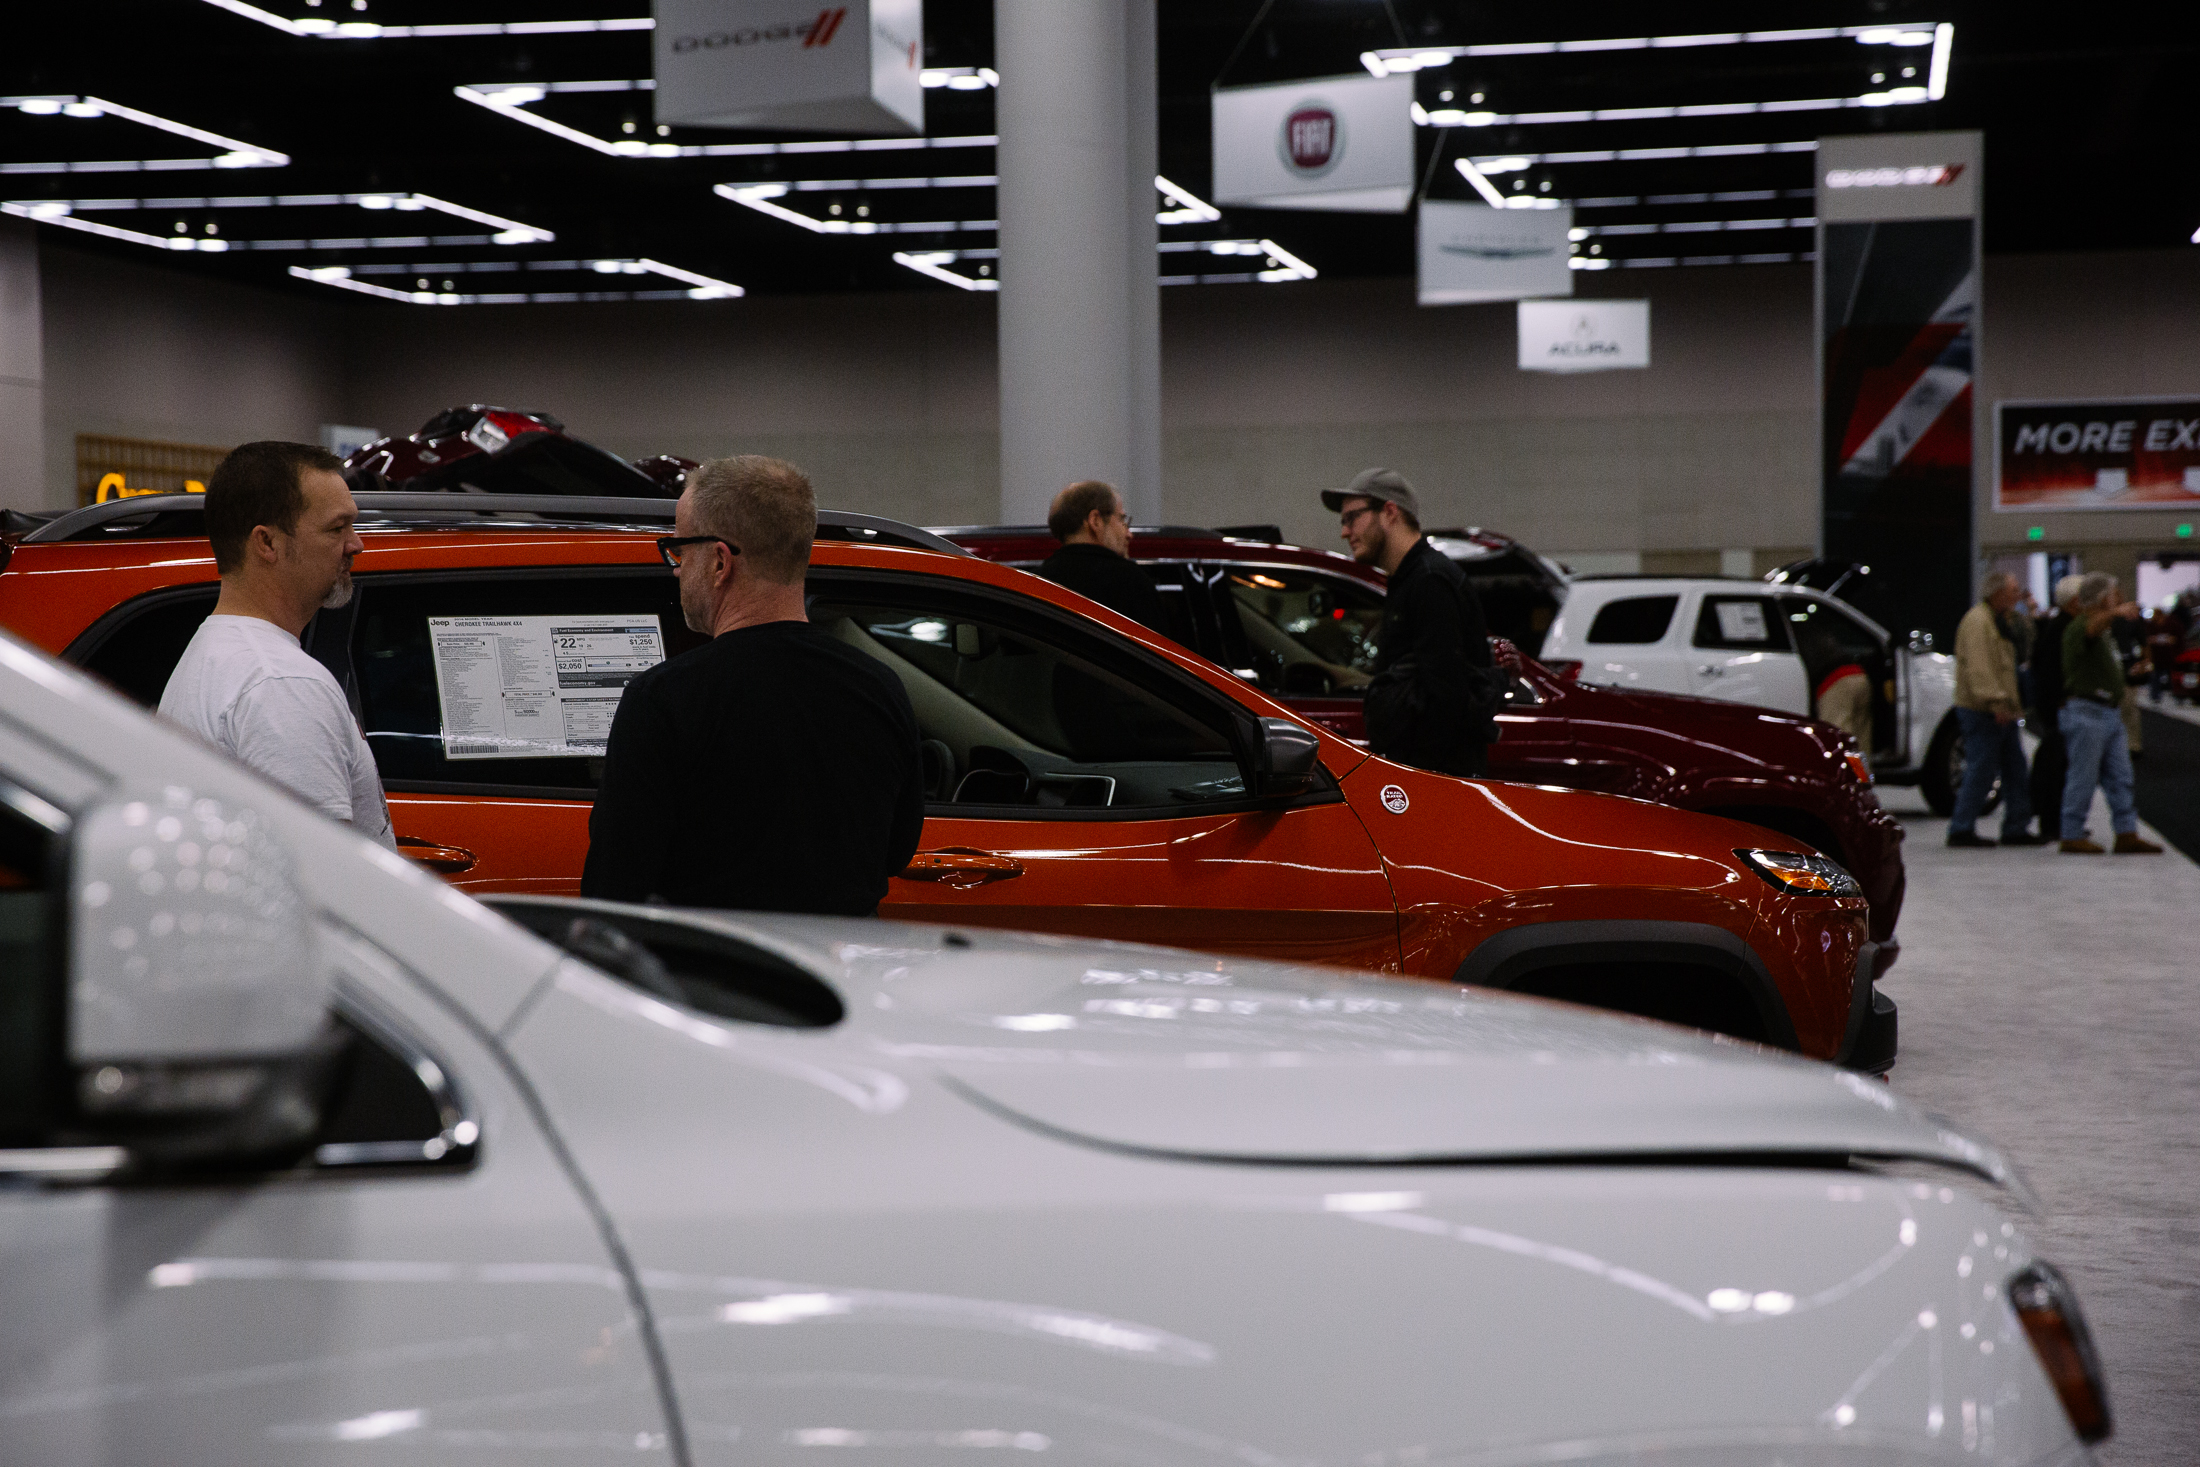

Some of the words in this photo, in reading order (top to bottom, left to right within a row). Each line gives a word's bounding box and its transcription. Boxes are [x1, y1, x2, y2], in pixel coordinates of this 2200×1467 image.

[1292, 118, 1330, 157] FIAT
[1547, 340, 1620, 357] ACURA
[2014, 420, 2137, 455] MORE
[2144, 418, 2200, 452] EX
[430, 619, 450, 627] Jeep
[560, 637, 577, 648] 22
